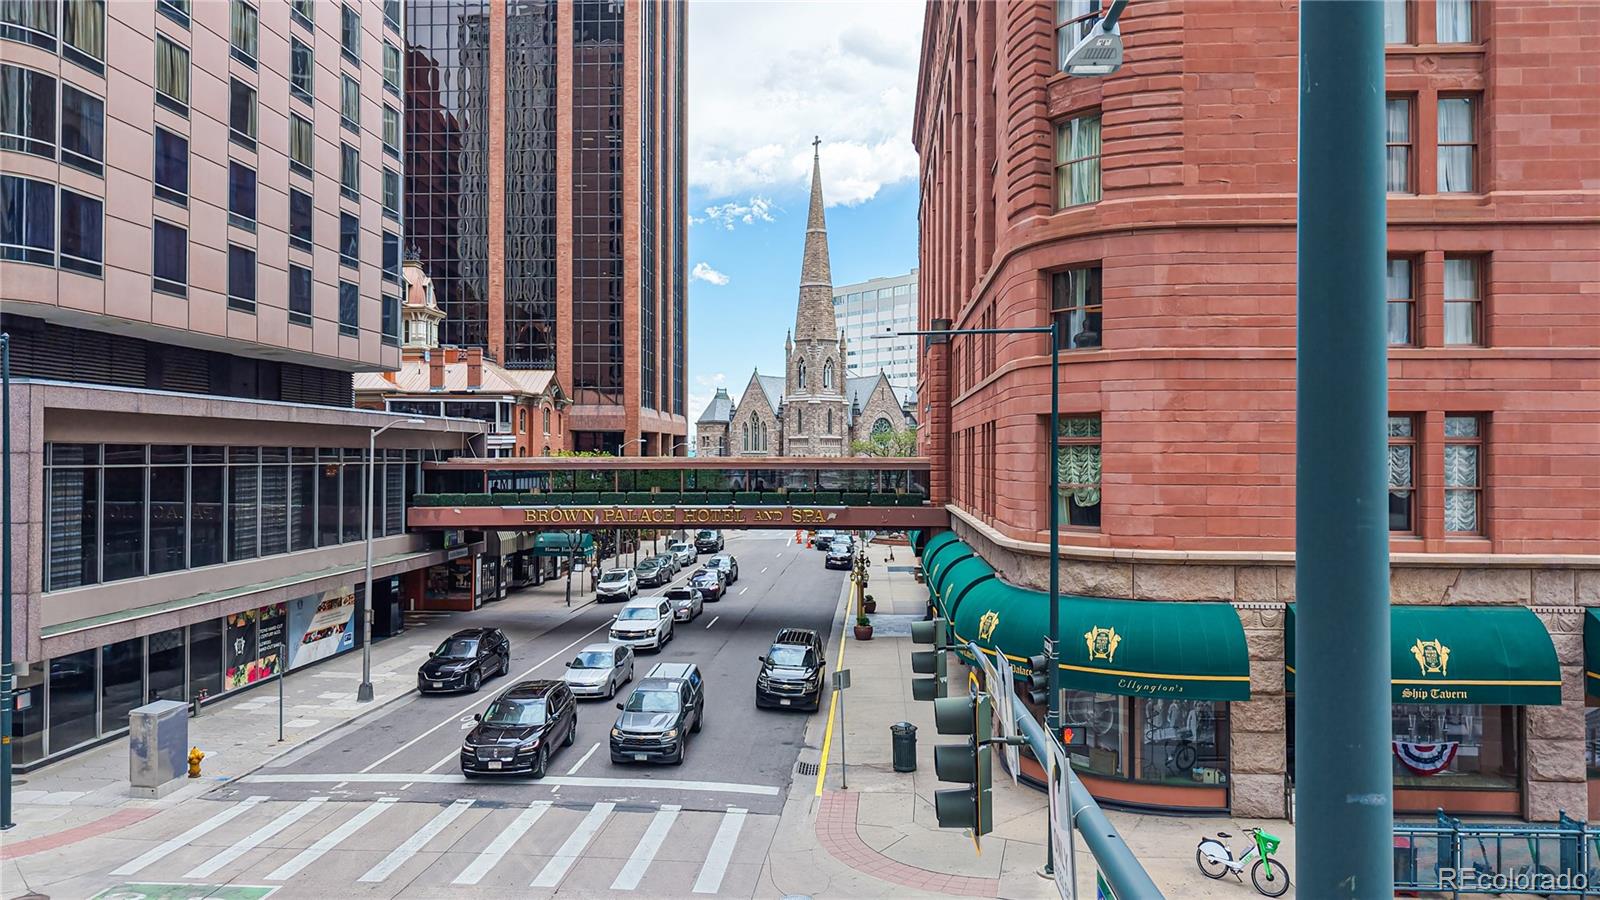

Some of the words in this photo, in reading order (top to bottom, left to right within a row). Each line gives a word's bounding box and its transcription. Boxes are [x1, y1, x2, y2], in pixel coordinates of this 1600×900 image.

[524, 508, 595, 523] BROWN
[603, 508, 675, 523] PALACE
[683, 508, 746, 523] HOTEL
[753, 510, 783, 522] AND
[791, 508, 827, 523] SPA
[1010, 663, 1033, 676] Palace
[1402, 688, 1428, 700] Ship
[1430, 688, 1468, 699] Tavern
